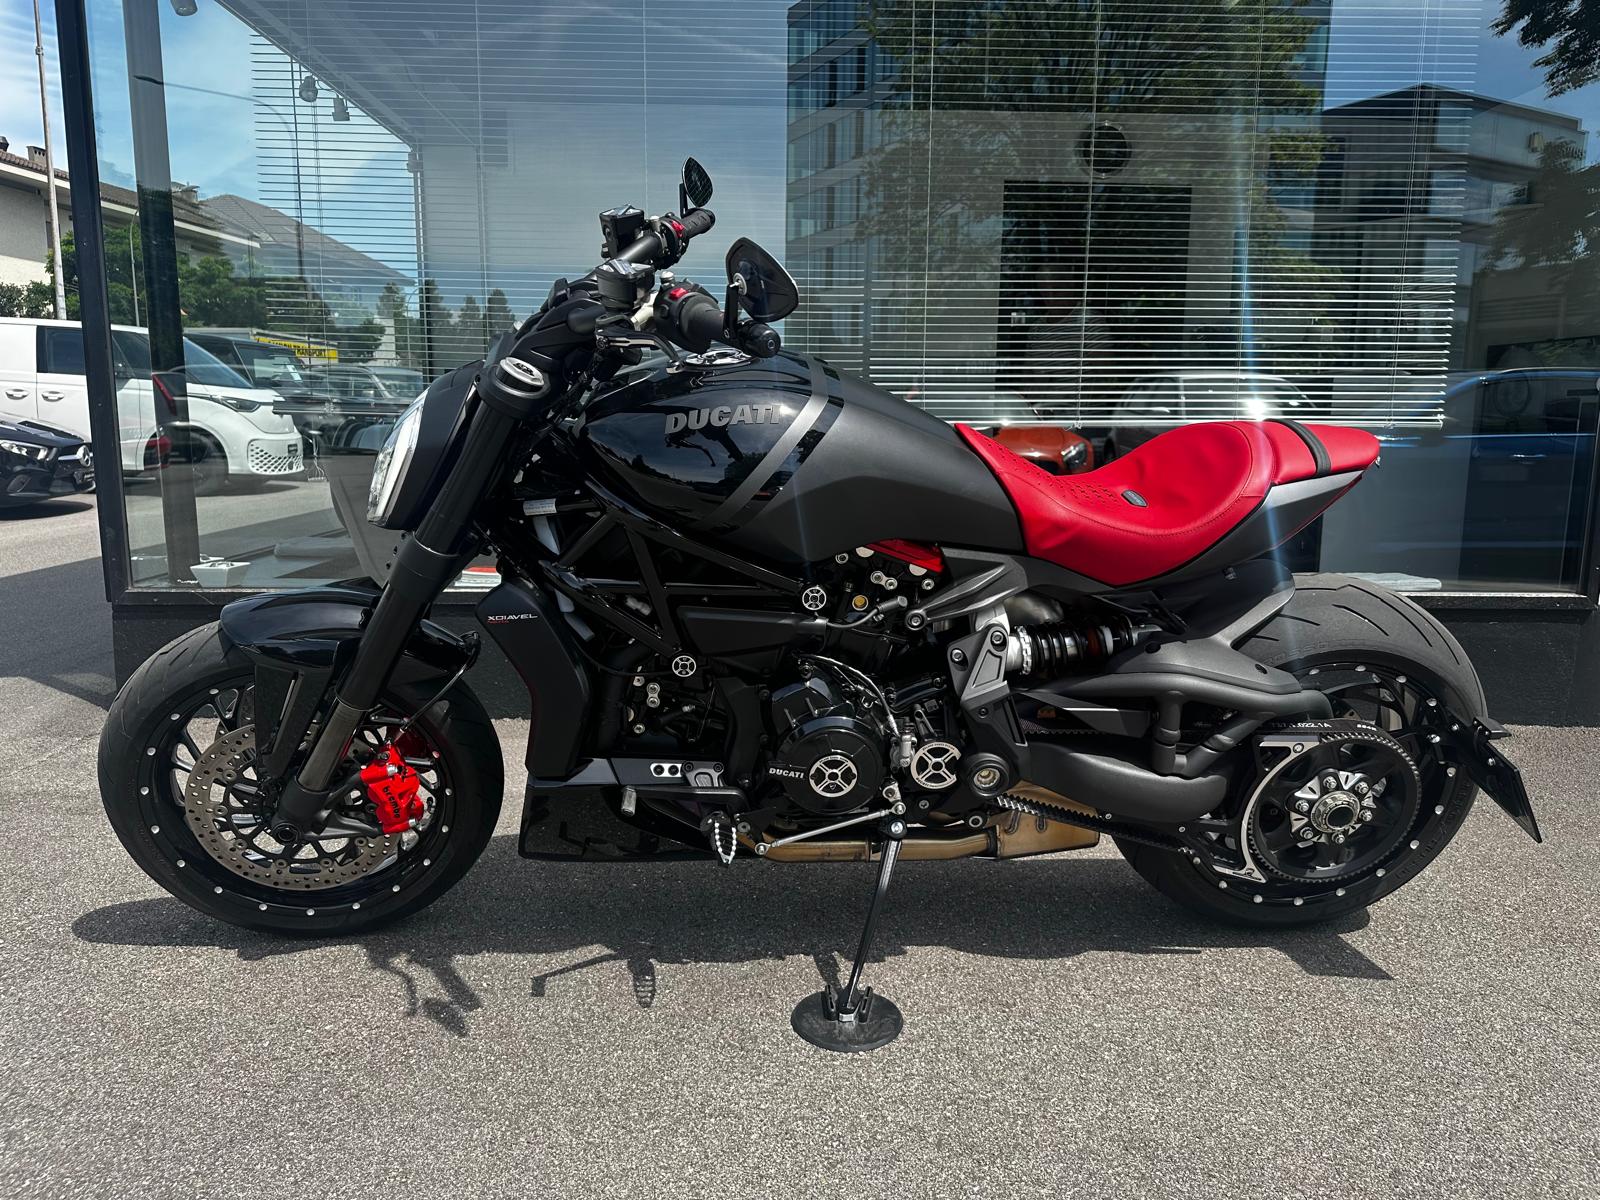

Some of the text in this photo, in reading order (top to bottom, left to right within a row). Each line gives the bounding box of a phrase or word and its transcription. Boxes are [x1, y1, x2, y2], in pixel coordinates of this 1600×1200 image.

[664, 404, 781, 435] DUCATI
[487, 613, 538, 621] XDIAVEL
[768, 767, 805, 779] DUCATI
[383, 785, 401, 818] brembo
